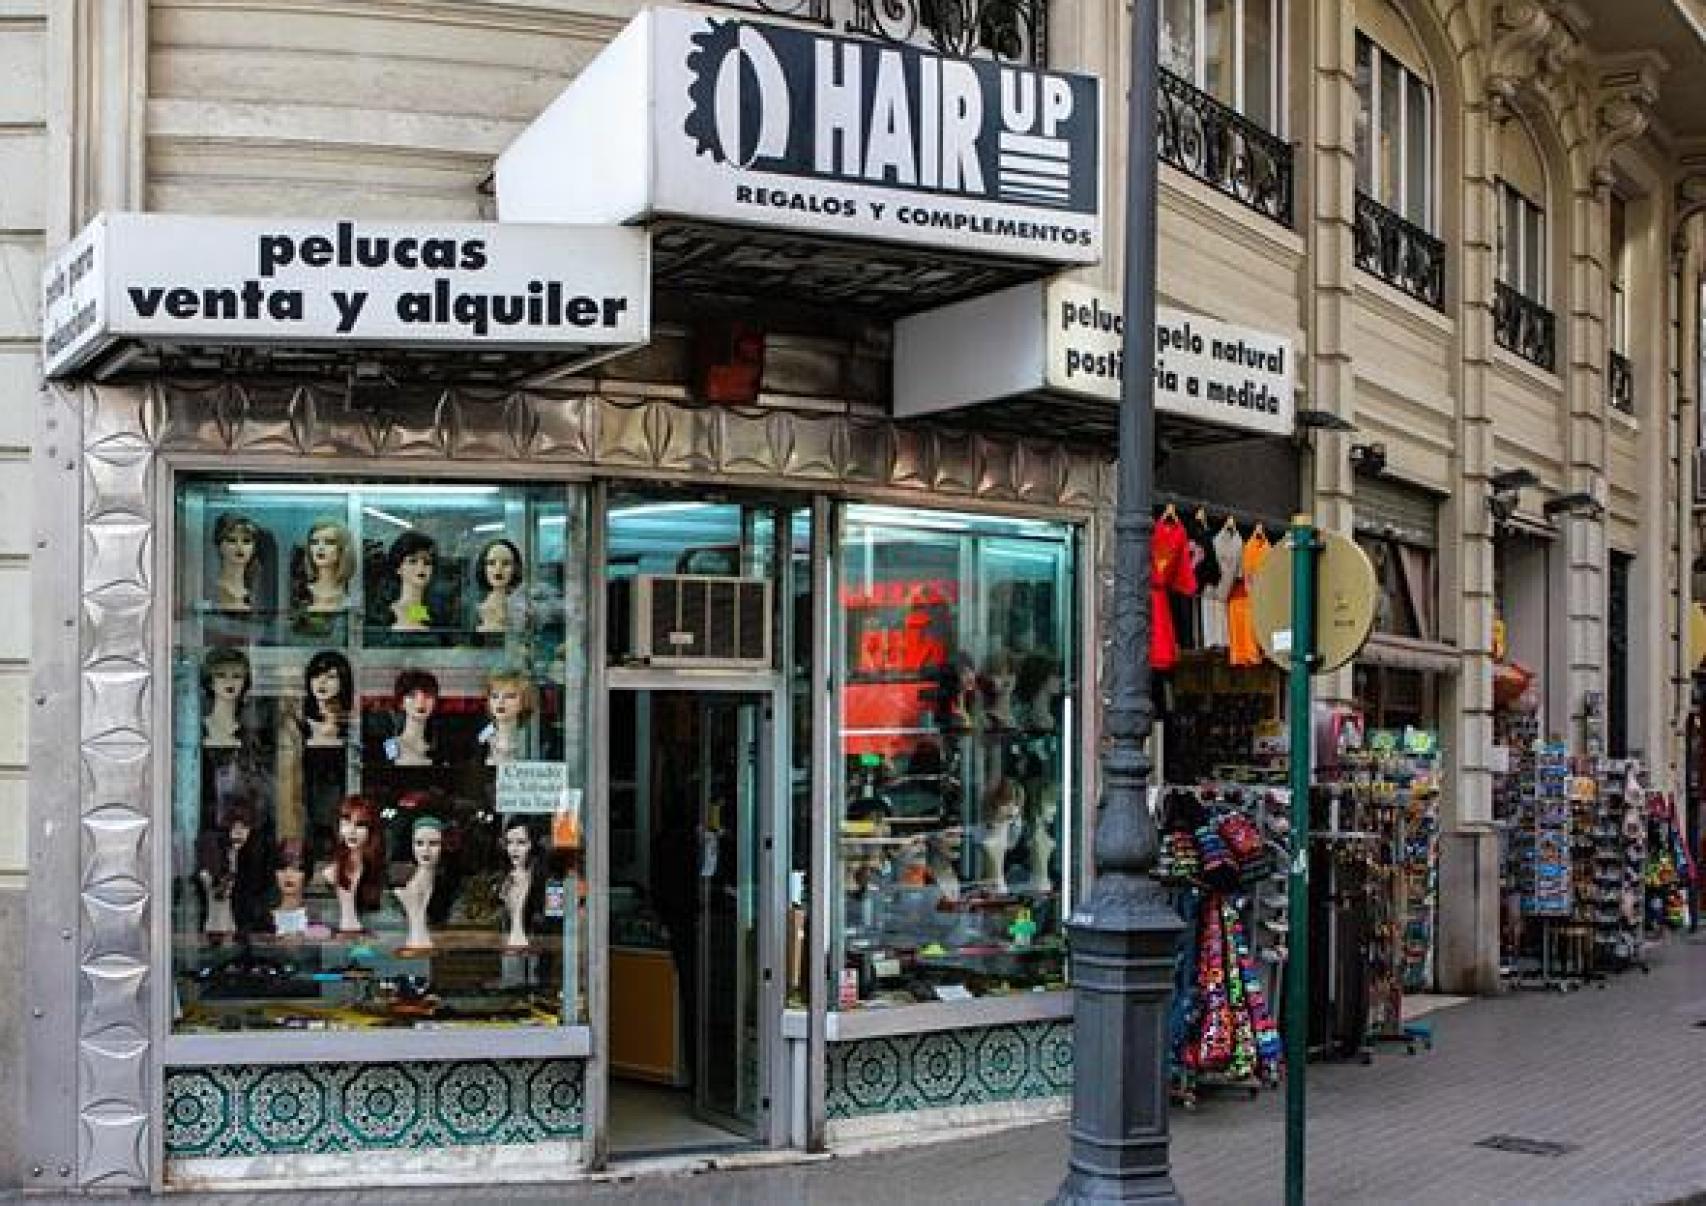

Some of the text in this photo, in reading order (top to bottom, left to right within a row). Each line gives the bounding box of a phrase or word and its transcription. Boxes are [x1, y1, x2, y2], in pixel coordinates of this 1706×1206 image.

[814, 38, 1073, 194] HAIR UP
[736, 185, 1092, 246] REGALOS Y COMPLEMENTOS
[259, 222, 488, 277] pelucas
[127, 278, 628, 336] venta y alquiler
[1157, 322, 1203, 354] pelo
[1212, 339, 1284, 375] natural
[1186, 376, 1199, 397] a
[1206, 380, 1281, 415] medida
